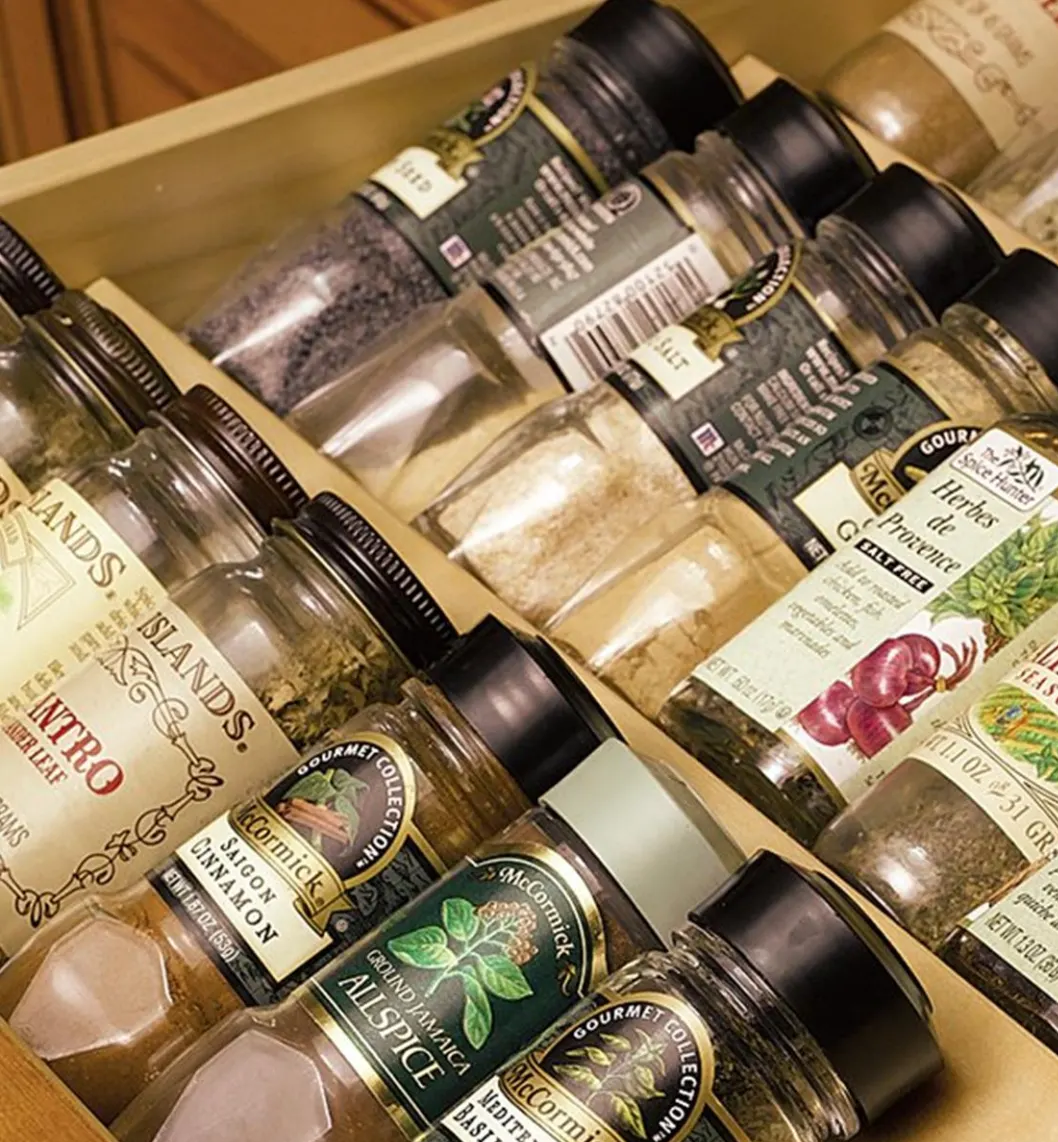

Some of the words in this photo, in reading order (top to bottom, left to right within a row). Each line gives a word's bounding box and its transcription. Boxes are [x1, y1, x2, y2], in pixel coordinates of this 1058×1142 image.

[931, 478, 1000, 530] Herbes
[957, 452, 993, 481] Spice
[992, 472, 1036, 505] Hunter
[858, 538, 892, 566] SALT
[894, 560, 931, 593] FREE
[878, 512, 962, 574] Provence
[927, 513, 957, 537] de
[137, 611, 255, 743] ISLANDS
[298, 743, 378, 776] GOURMET
[362, 756, 403, 866] COLLECTION
[962, 754, 989, 785] OZ
[189, 835, 280, 945] CINNAMON
[219, 836, 278, 905] SAIGON
[498, 866, 575, 961] McCormick
[338, 973, 446, 1089] ALLSPICE
[365, 948, 415, 1003] GROUND
[408, 997, 472, 1077] JAMAICA
[573, 1004, 664, 1041] GOURMET
[655, 1018, 699, 1136] COLLECTION
